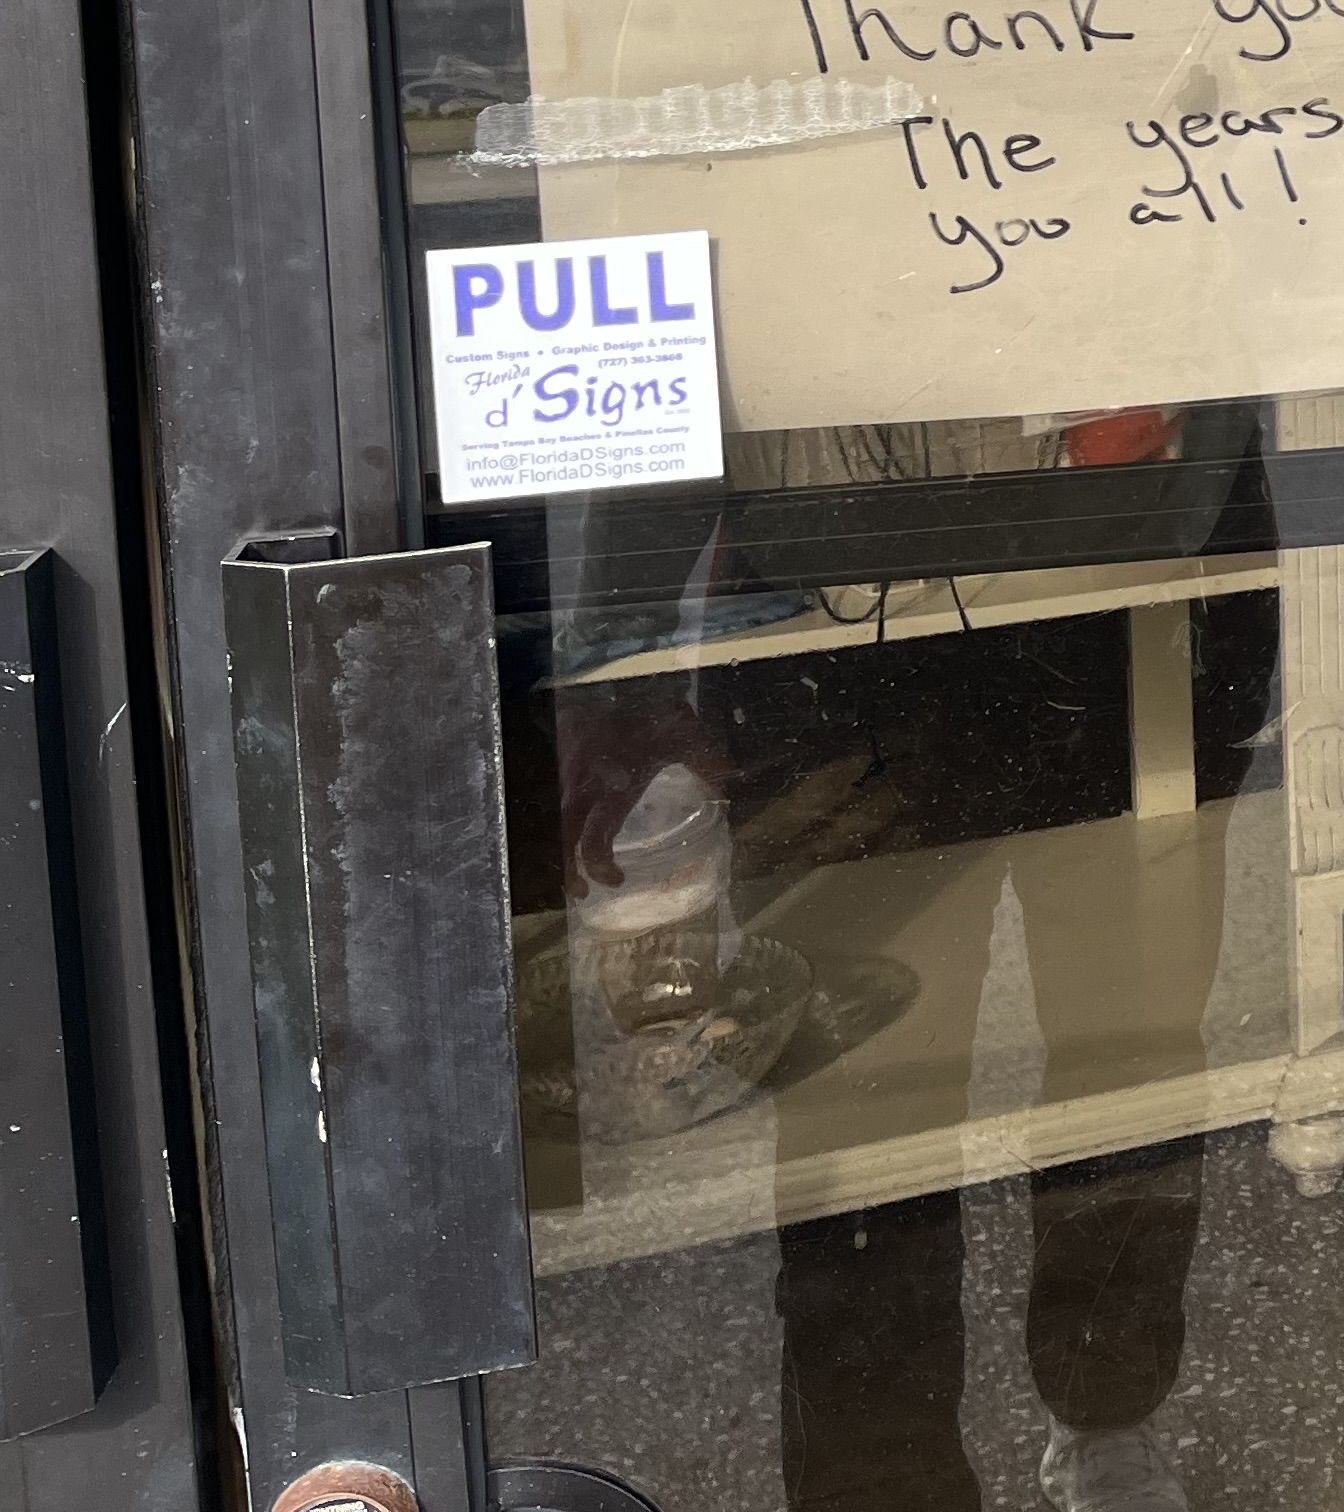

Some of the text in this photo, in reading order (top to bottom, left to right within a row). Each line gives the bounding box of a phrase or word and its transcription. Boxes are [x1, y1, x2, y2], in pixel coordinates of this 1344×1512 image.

[897, 112, 1058, 194] The
[929, 208, 1070, 292] you
[452, 250, 696, 338] PULL
[446, 336, 707, 364] Custom Signs Graphic Design & Printing
[598, 357, 628, 369] (727)
[464, 363, 531, 396] Florida
[462, 443, 499, 451] Serving
[501, 439, 535, 448] Tampa
[559, 432, 601, 442] Beaches
[466, 442, 686, 472] info@FloridaDSigns.com
[470, 458, 686, 488] www.FloridaDSigns.com
